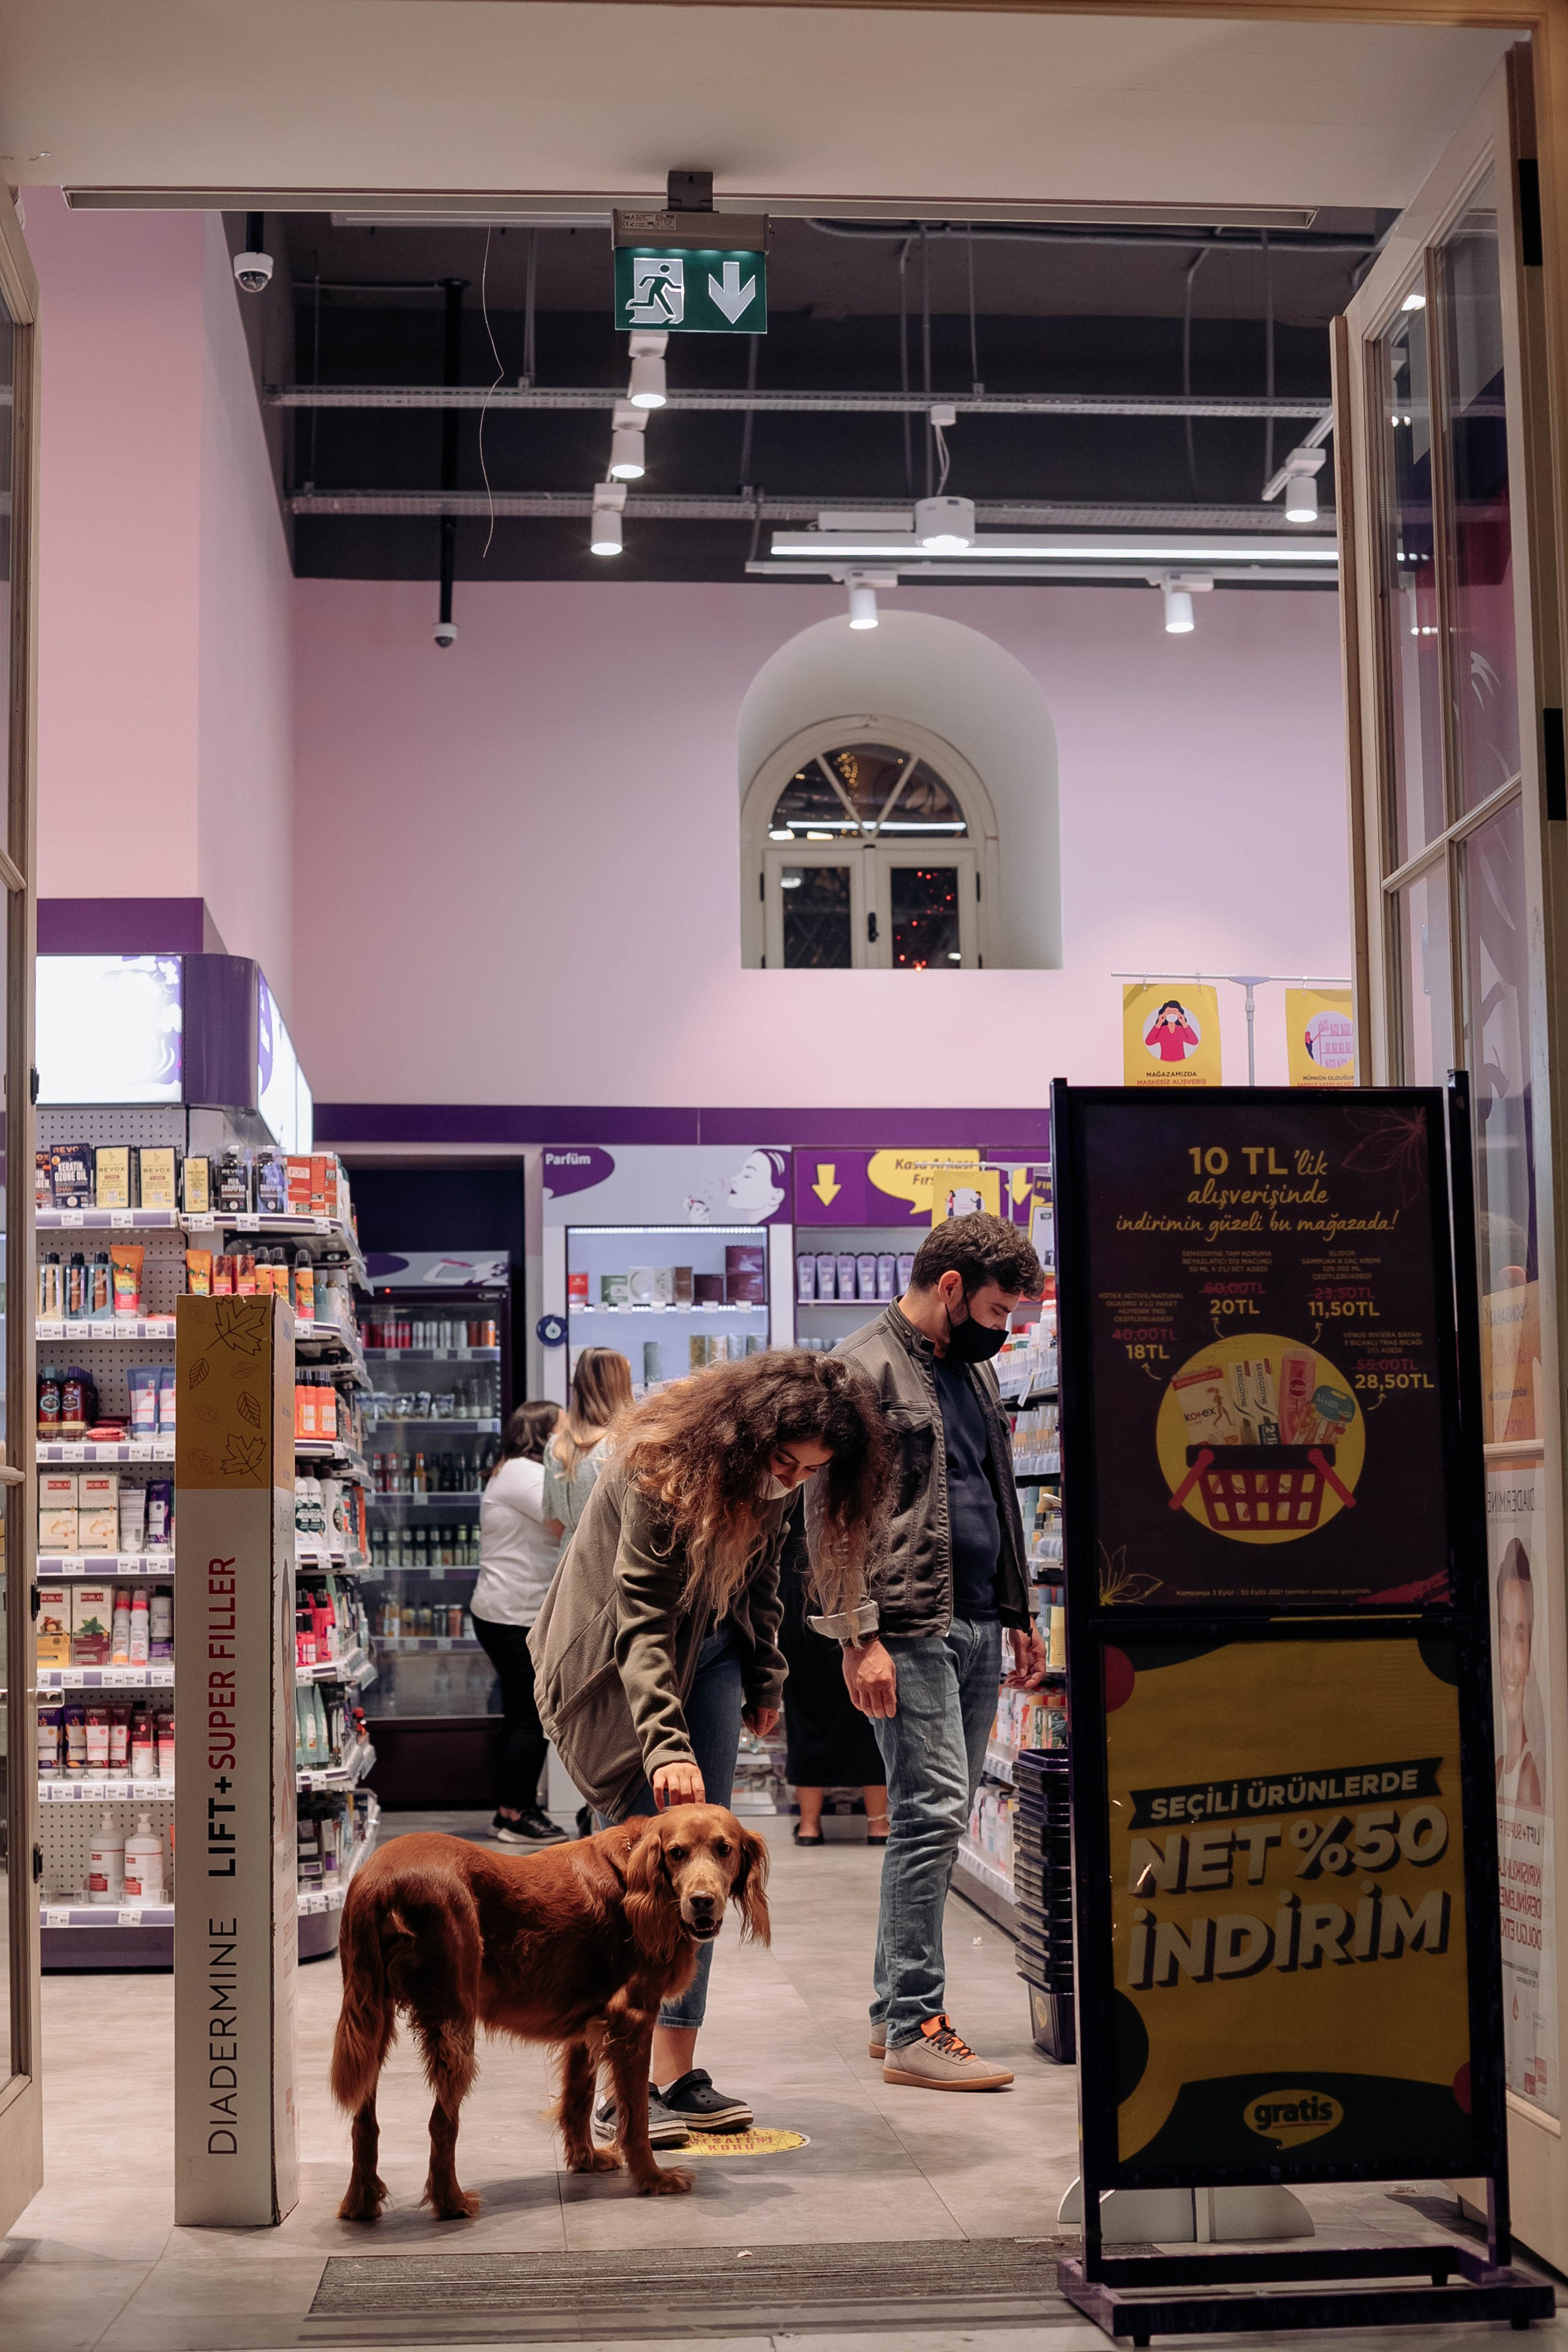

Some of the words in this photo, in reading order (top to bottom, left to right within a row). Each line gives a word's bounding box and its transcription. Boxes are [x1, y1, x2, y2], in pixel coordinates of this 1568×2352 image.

[545, 1152, 591, 1166] Parfüm
[895, 1158, 927, 1170] Kasa
[1188, 1147, 1229, 1175] 10
[1242, 1147, 1289, 1175] TL
[1188, 1178, 1329, 1210] alışverişinde
[1117, 1211, 1204, 1232] indirimin
[1206, 1211, 1264, 1242] güzeli
[1270, 1211, 1292, 1231] bu
[1297, 1209, 1399, 1242] mağazada!
[1210, 1299, 1260, 1314] 20TL
[1308, 1302, 1380, 1319] 11,50TL
[1126, 1344, 1170, 1359] 18TL
[1235, 1365, 1247, 1408] SENSODYNE
[1256, 1362, 1268, 1405] SENSODYNE
[1355, 1374, 1435, 1392] 28,50TL
[1184, 1406, 1217, 1422] kotex
[208, 1556, 236, 1660] FILLER
[1151, 1785, 1238, 1820] SEÇİLİ
[1246, 1768, 1419, 1809] ÜRÜNLERDE
[1128, 1822, 1282, 1898] NET
[1288, 1804, 1449, 1879] %50
[1127, 1880, 1450, 1991] İNDİRİM
[208, 1917, 238, 2155] DIADERMINE
[1254, 2095, 1333, 2130] gratis
